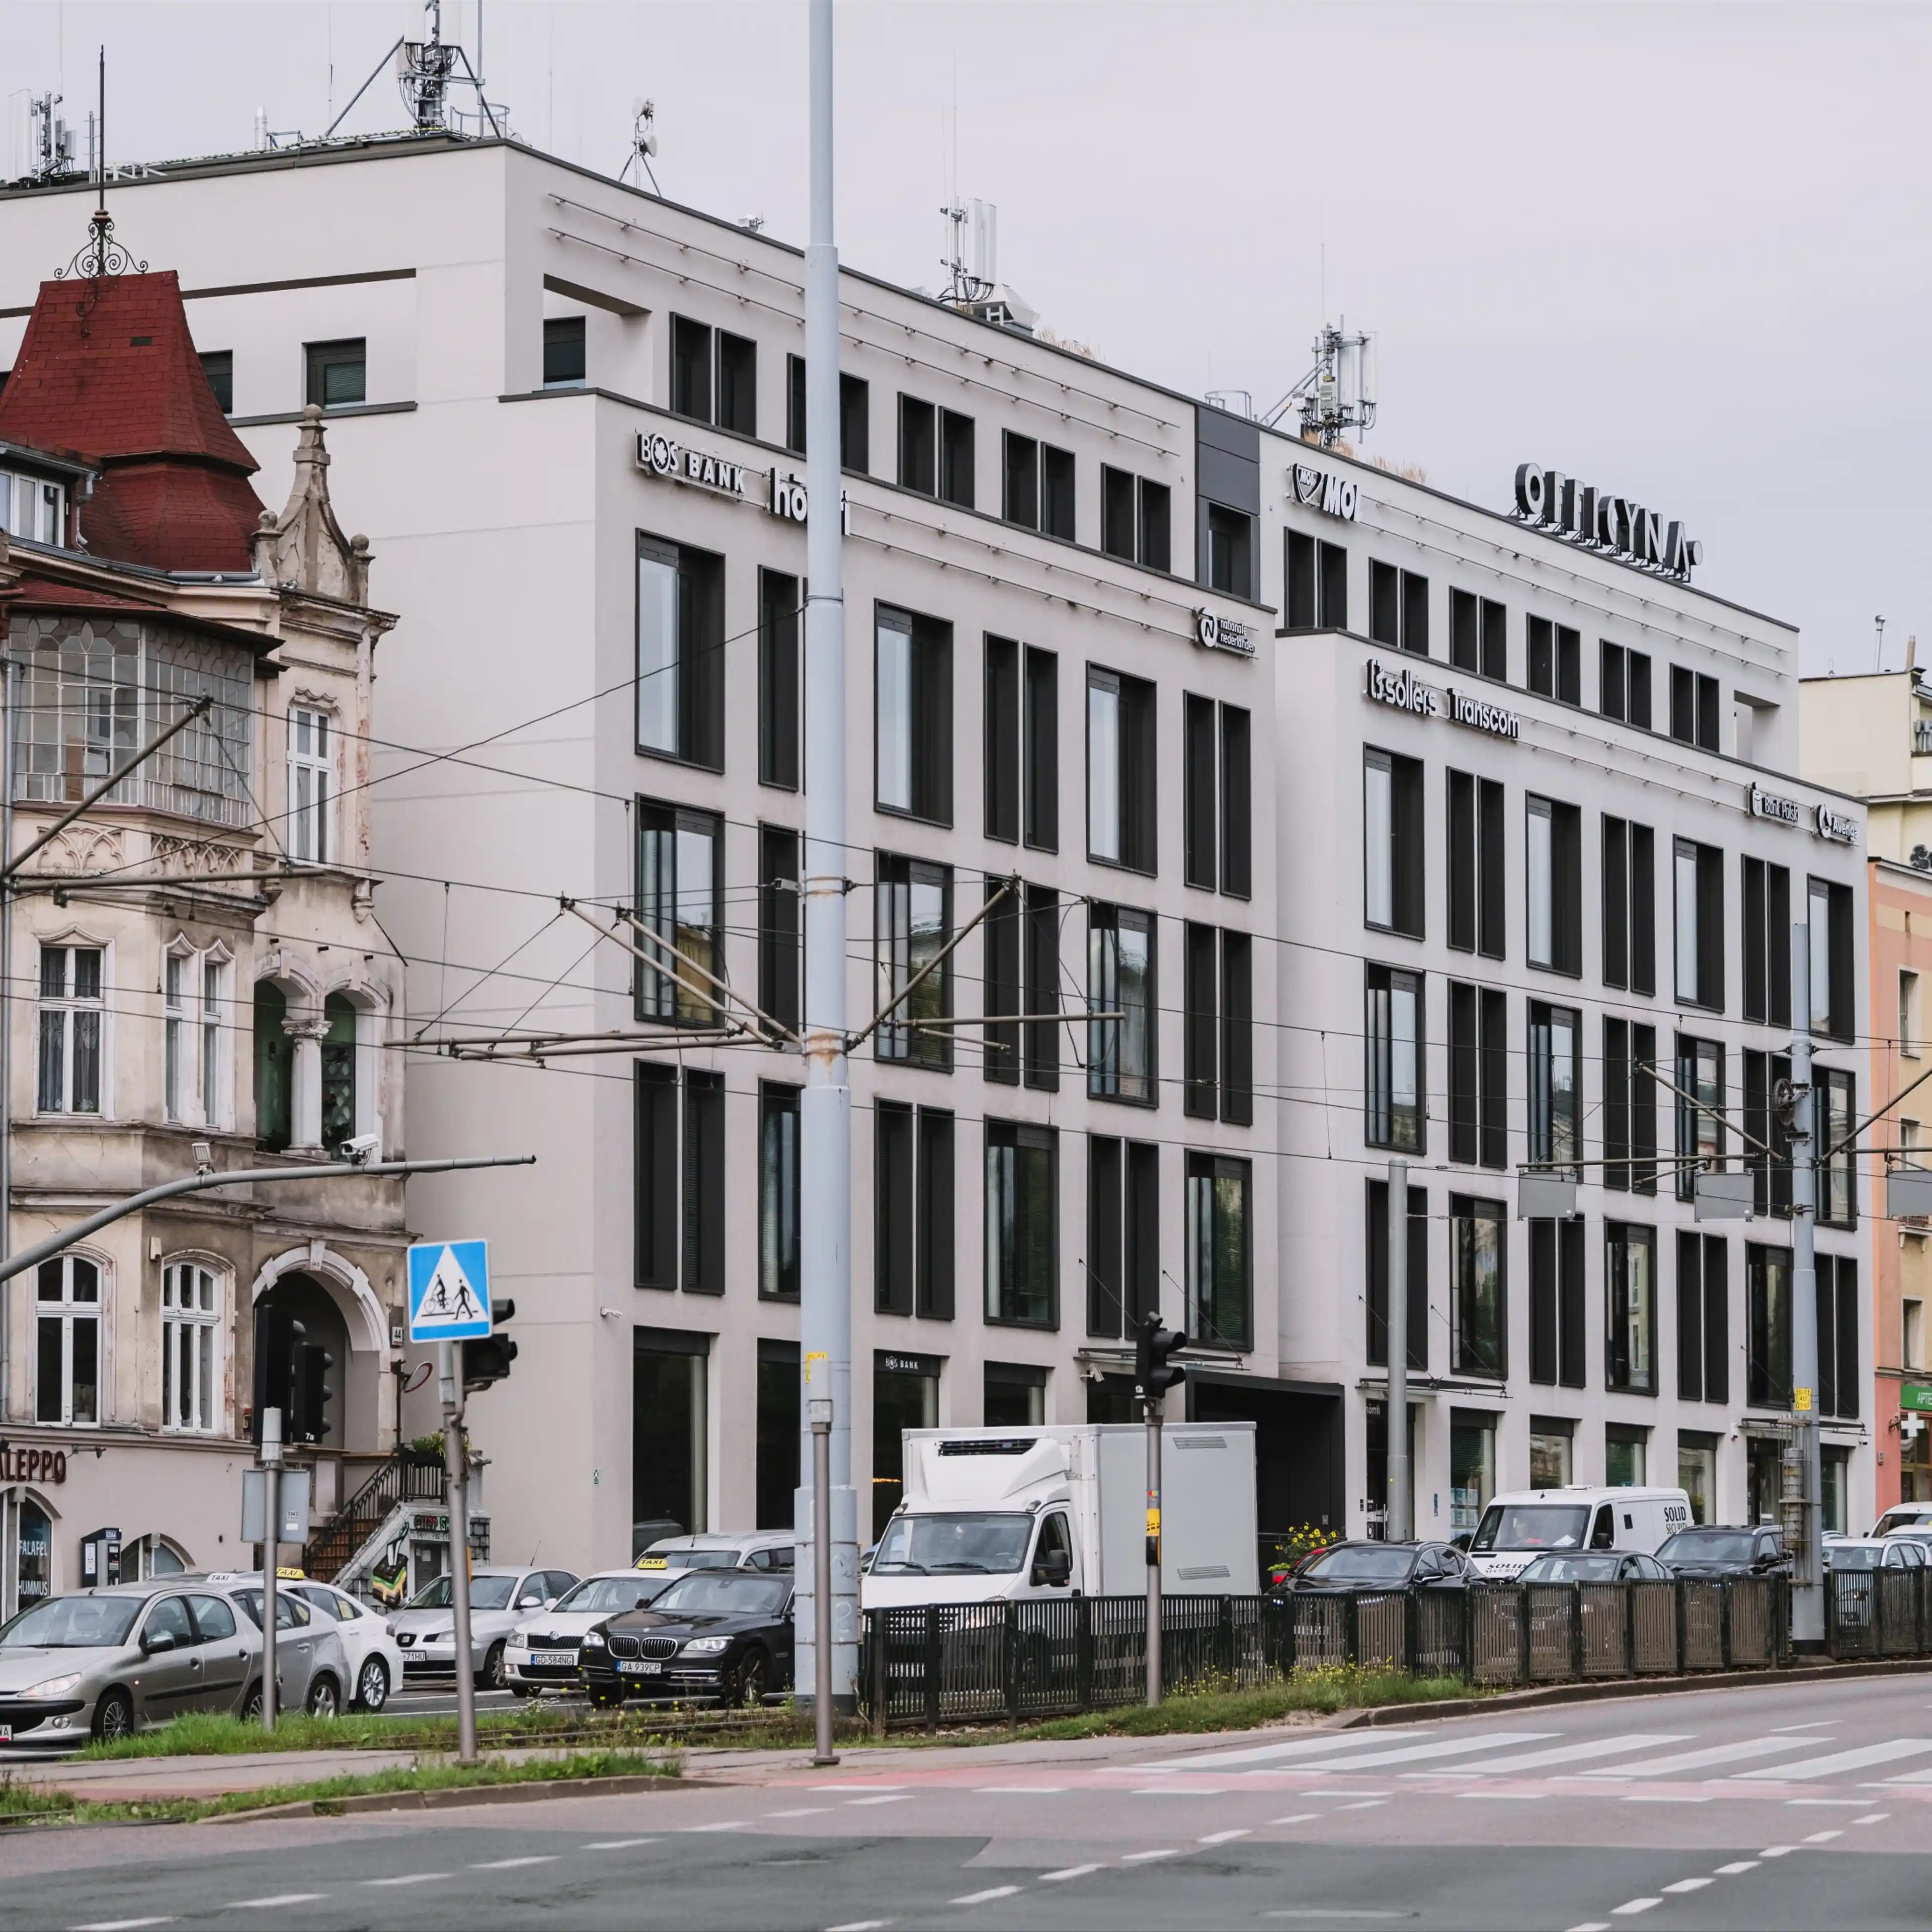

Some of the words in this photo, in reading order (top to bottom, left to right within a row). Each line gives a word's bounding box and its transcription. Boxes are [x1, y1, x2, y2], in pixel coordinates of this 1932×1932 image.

[686, 452, 746, 494] BANK
[1447, 687, 1521, 738] Transcom
[900, 1359, 919, 1370] BANK
[0, 1449, 66, 1484] LEPPO
[1664, 1506, 1686, 1522] SOLID
[19, 1540, 48, 1557] FALAFEL
[19, 1580, 48, 1596] HUMMUS
[536, 1656, 545, 1664] GD
[548, 1656, 572, 1665] 584NG
[621, 1662, 632, 1671] GA
[634, 1663, 660, 1673] 939CP
